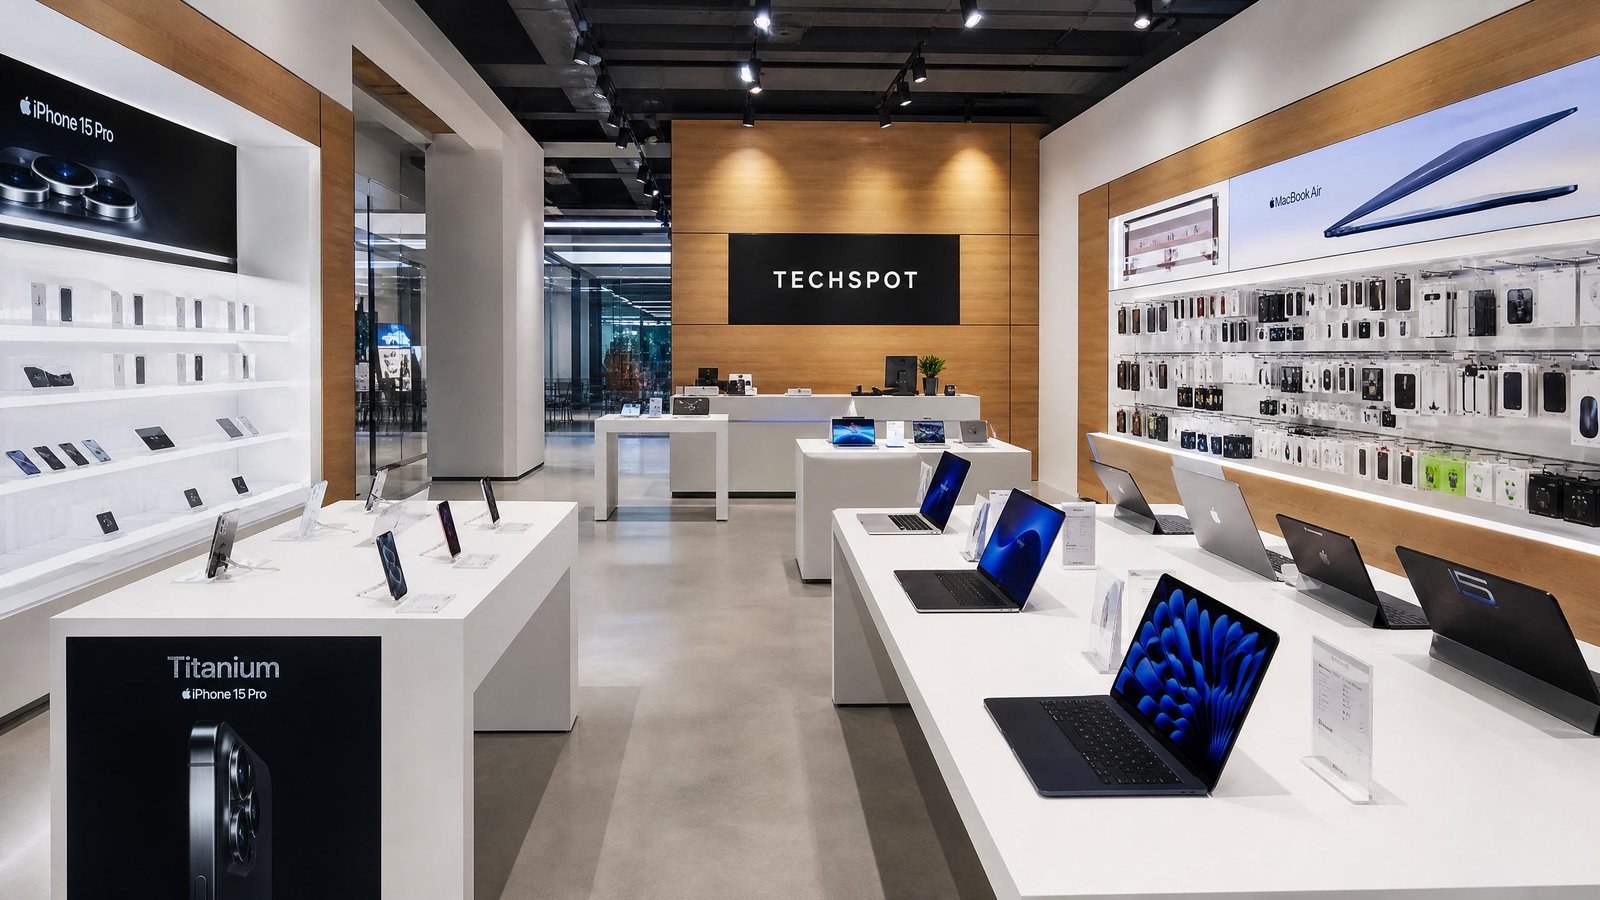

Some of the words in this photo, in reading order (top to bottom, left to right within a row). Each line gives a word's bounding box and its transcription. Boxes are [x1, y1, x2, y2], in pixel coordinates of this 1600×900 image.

[33, 100, 78, 131] iPhone
[79, 116, 93, 136] 15
[95, 121, 114, 143] Pro
[1275, 188, 1310, 207] MacBook
[1311, 185, 1322, 198] Air
[773, 270, 918, 289] TECHSPOT
[167, 655, 280, 679] Titanium
[192, 688, 231, 700] iPhone
[233, 688, 246, 700] 15
[248, 688, 267, 700] Pro
